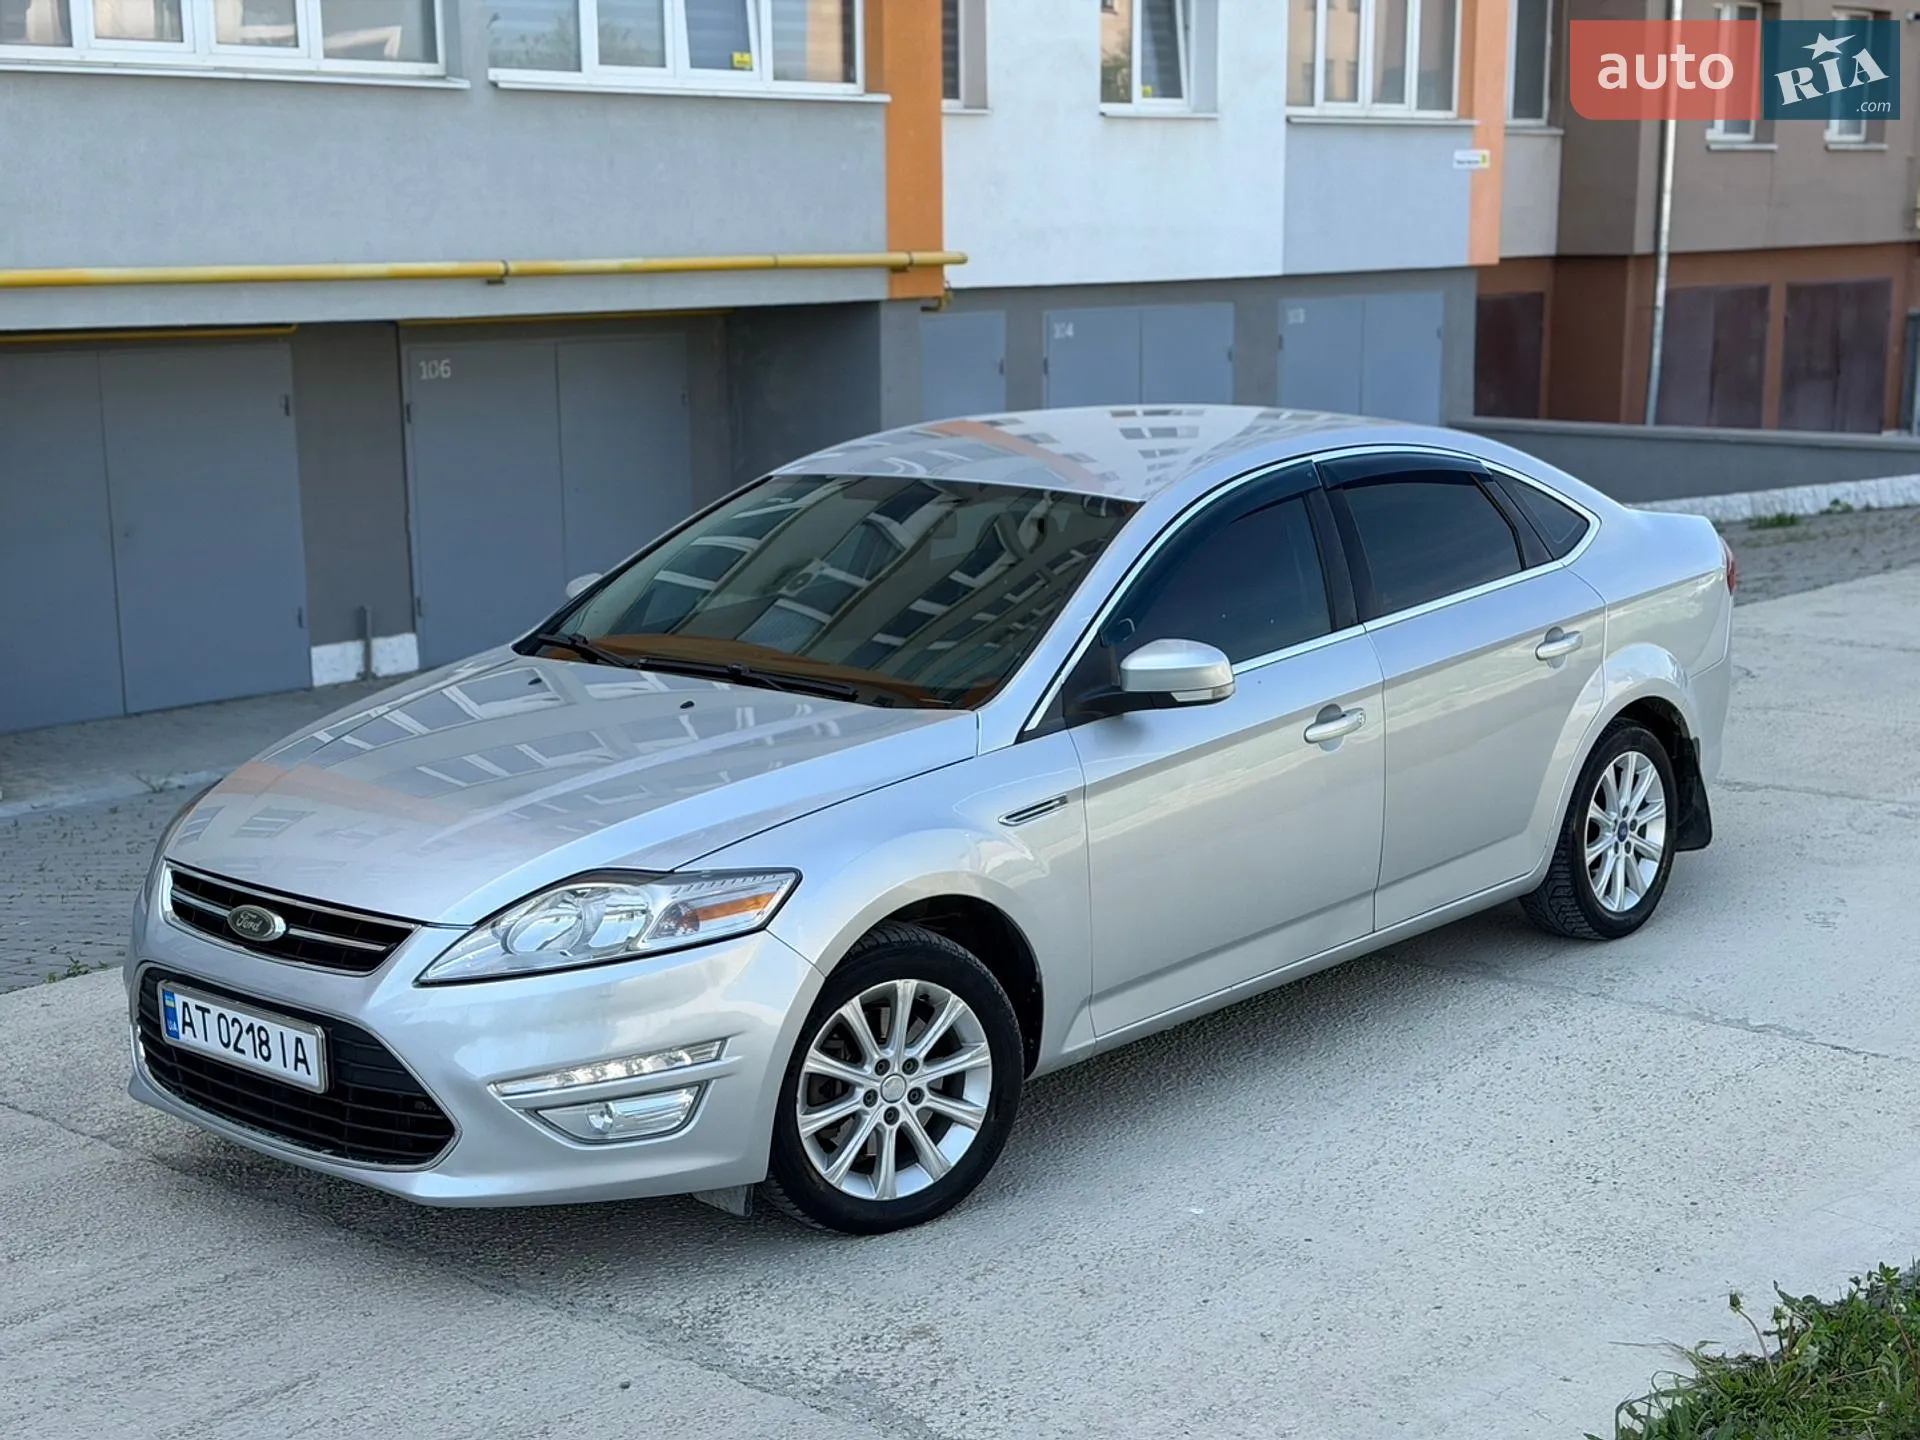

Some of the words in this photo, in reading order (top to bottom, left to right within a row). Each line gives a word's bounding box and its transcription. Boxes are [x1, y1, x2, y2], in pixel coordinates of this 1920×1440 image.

[419, 358, 452, 380] 106
[236, 911, 263, 932] Ford
[182, 1001, 211, 1042] AT
[218, 1013, 272, 1062] 0218
[280, 1031, 311, 1076] IA
